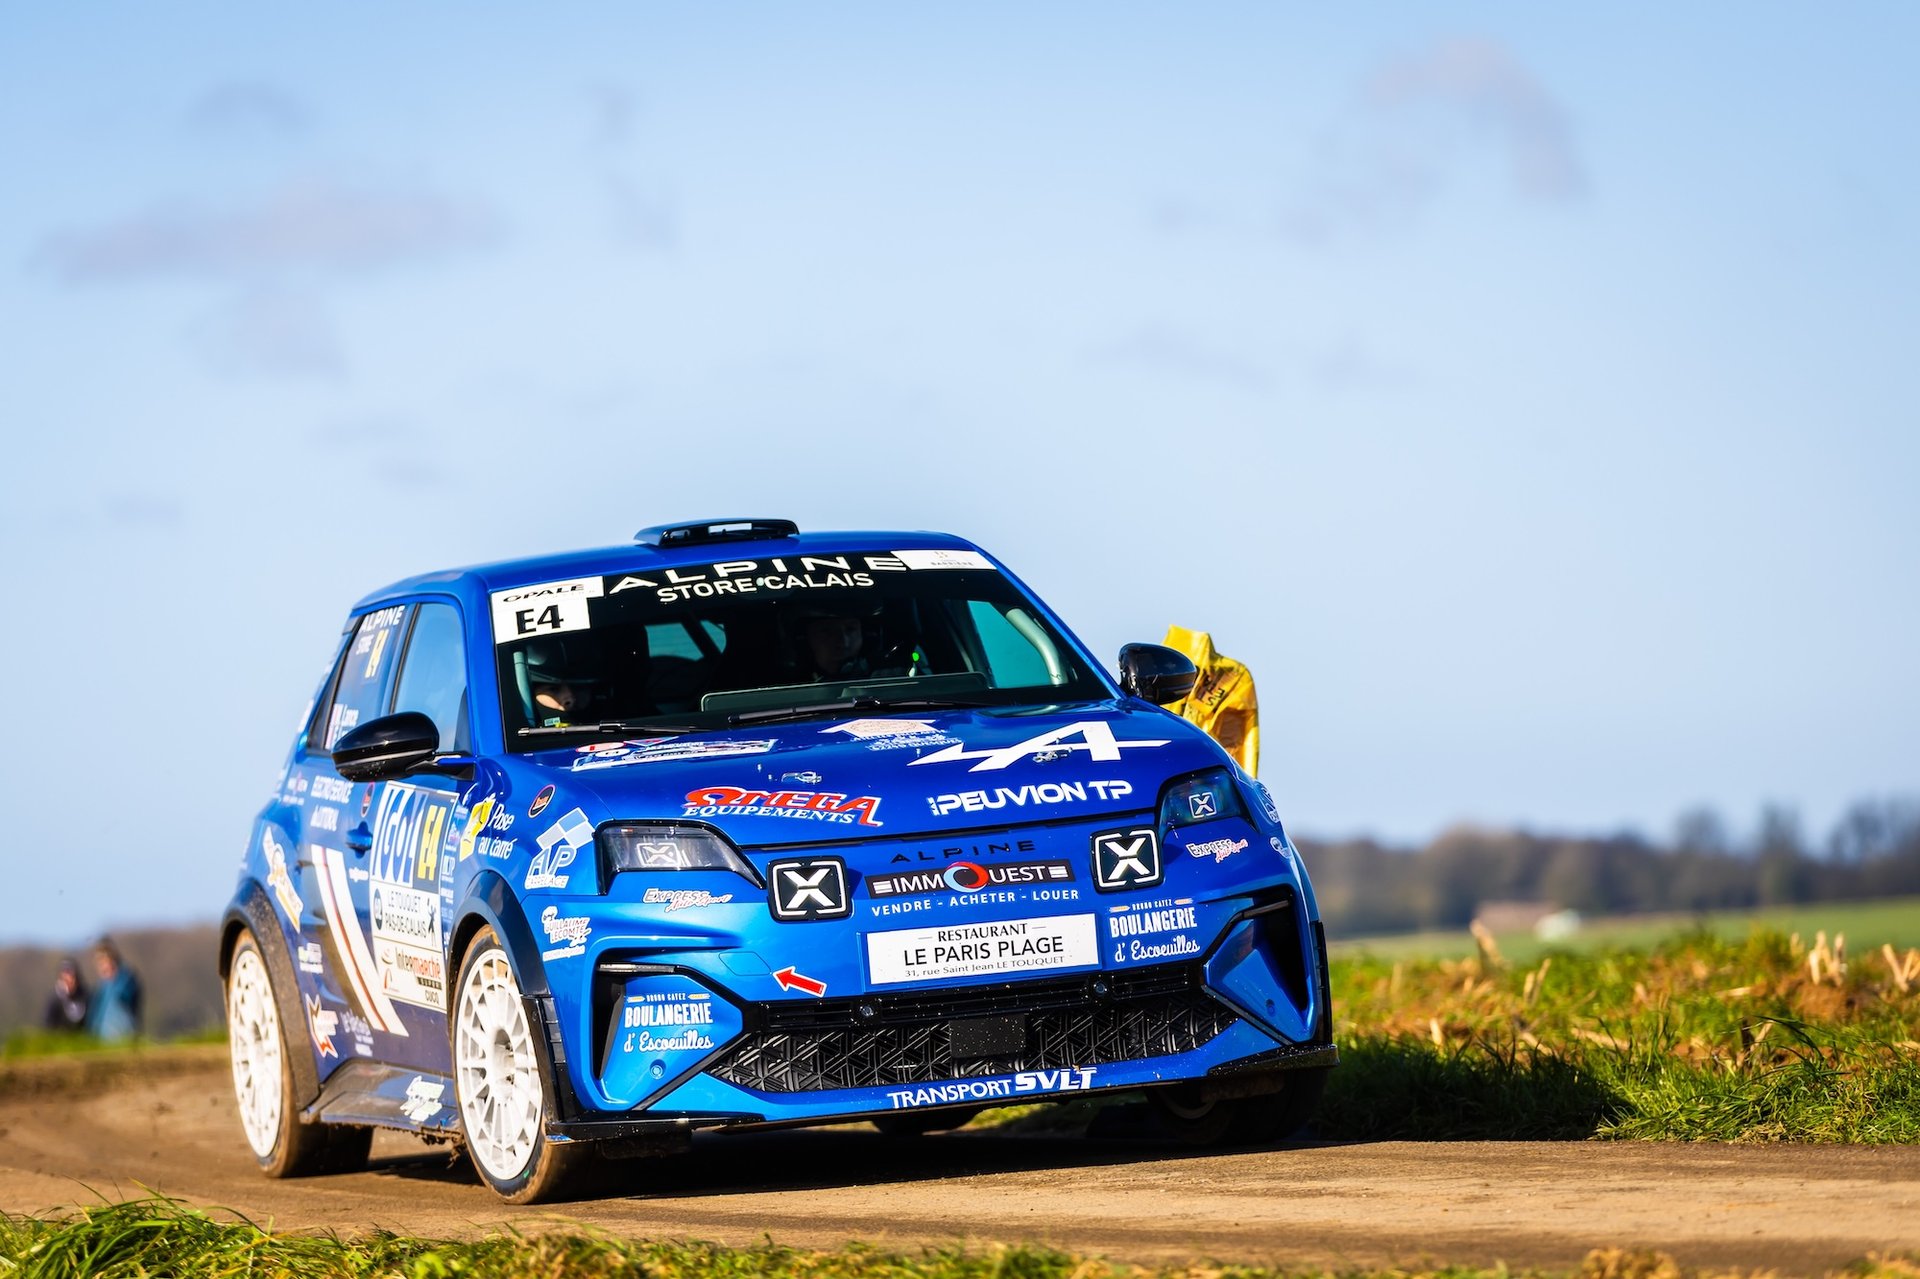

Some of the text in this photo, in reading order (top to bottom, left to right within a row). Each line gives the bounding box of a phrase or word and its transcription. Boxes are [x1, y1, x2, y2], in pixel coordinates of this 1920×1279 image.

[609, 556, 906, 595] ALPINE
[657, 573, 874, 602] STORE CALAIS
[503, 584, 585, 602] OPALE
[359, 605, 405, 632] ALPINE
[516, 604, 564, 635] E4
[683, 786, 884, 827] OMEGA
[937, 782, 1088, 816] PEUVION
[1088, 780, 1133, 799] TP
[488, 803, 515, 831] Pose
[682, 805, 856, 824] EQUIPEMENTS
[478, 837, 487, 854] au
[890, 840, 1036, 864] ALPINE
[528, 846, 577, 877] AP
[872, 900, 932, 917] VENDRE
[950, 892, 1015, 907] ACHETER
[1033, 890, 1079, 901] LOUER
[552, 925, 585, 942] LECOMTE
[938, 923, 1028, 943] RESTAURANT
[1109, 907, 1198, 938] BOULANGERIE
[395, 947, 441, 979] Intermarché
[904, 936, 1064, 966] LE PARIS PLAGE
[905, 956, 1065, 978] 31, rue Saint Jean LE TOUQUET
[624, 1003, 713, 1028] BOULANGERIE
[887, 1079, 1012, 1109] TRANSPORT
